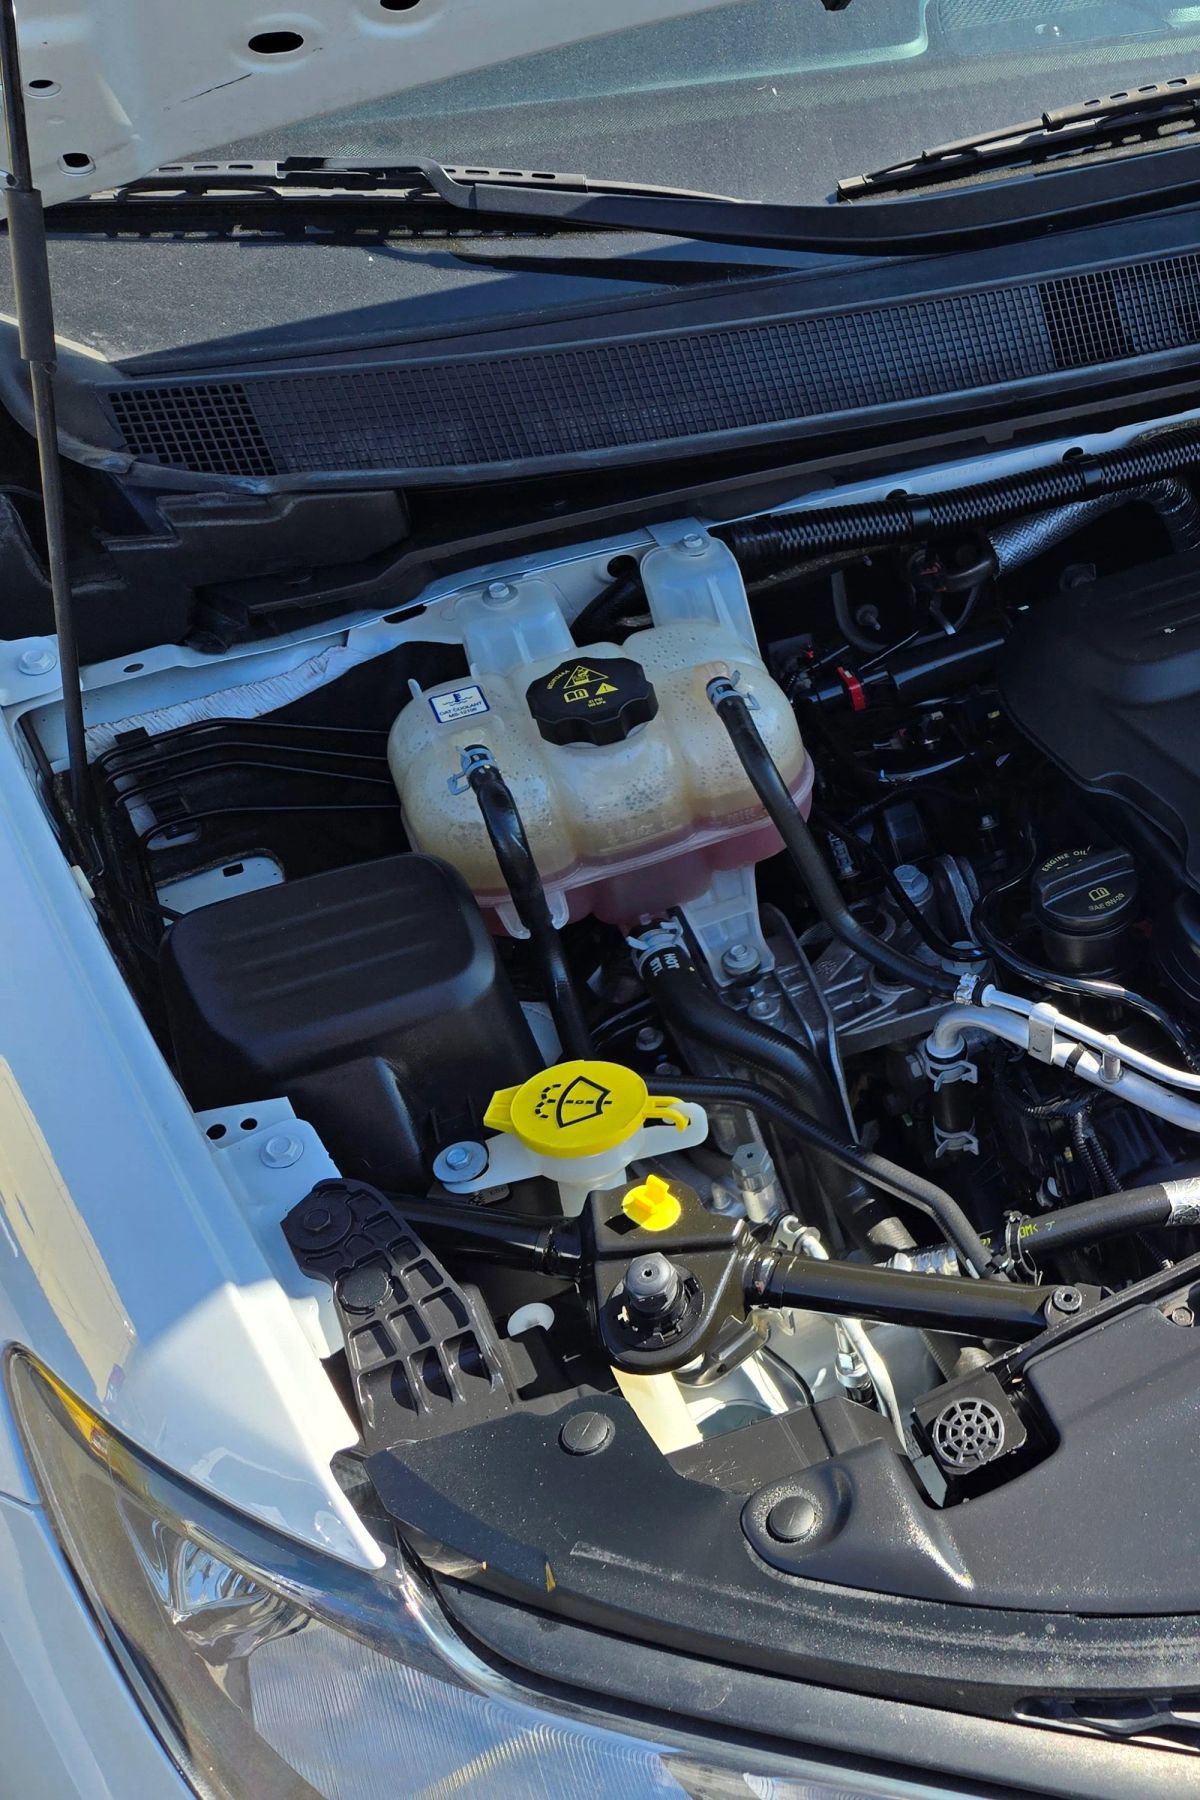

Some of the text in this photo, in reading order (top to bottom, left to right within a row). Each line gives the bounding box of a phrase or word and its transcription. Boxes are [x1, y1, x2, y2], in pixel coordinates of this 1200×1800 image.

[453, 701, 482, 711] COOLANT
[1041, 853, 1070, 872] ENGINE
[664, 953, 680, 969] HOT
